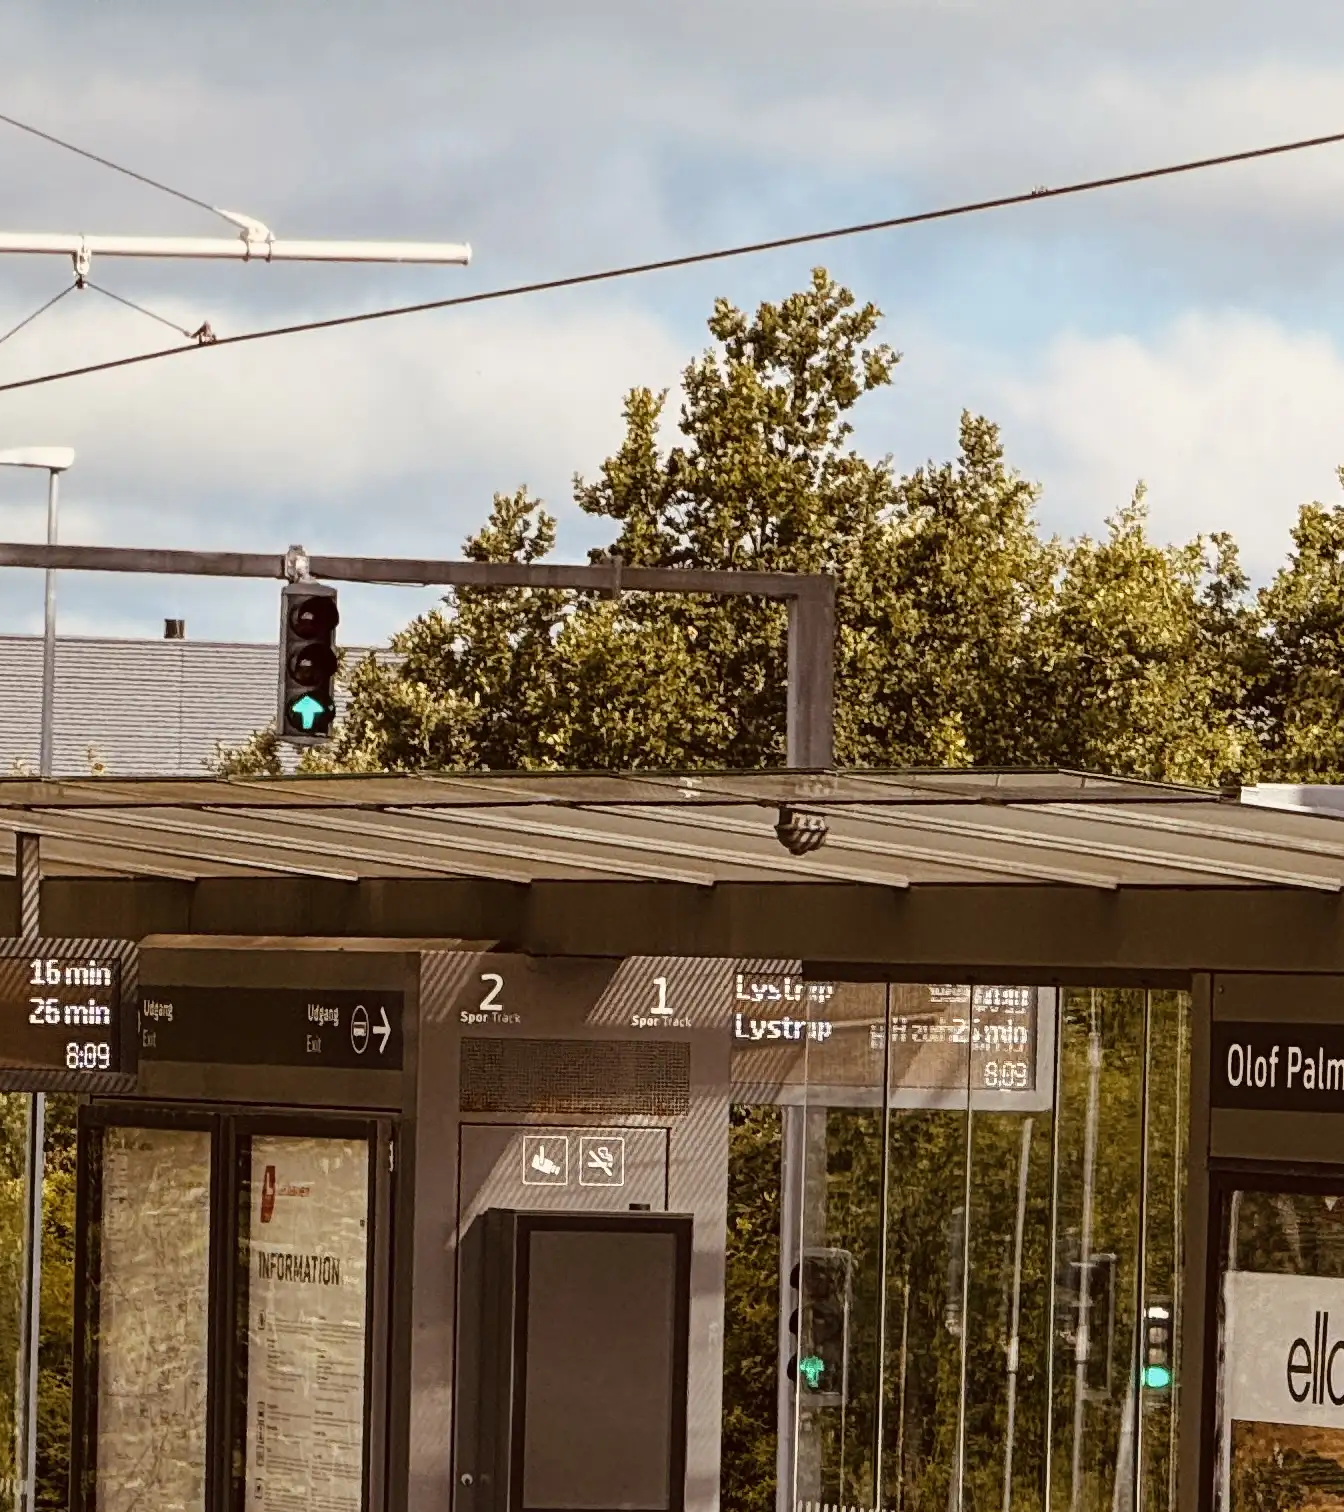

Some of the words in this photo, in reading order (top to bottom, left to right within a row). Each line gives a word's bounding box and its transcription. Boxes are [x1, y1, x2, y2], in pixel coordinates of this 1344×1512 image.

[29, 960, 61, 985] 16
[64, 960, 111, 987] min
[480, 973, 503, 1011] 2
[651, 977, 673, 1015] 1
[28, 998, 60, 1025] 26
[63, 998, 110, 1026] min
[460, 1011, 488, 1024] Spor
[492, 1014, 521, 1024] Track
[631, 1015, 659, 1028] Spor
[662, 1017, 692, 1028] Track
[65, 1042, 110, 1069] 8:09
[1227, 1043, 1280, 1088] Olof
[258, 1251, 341, 1286] INFORMATION
